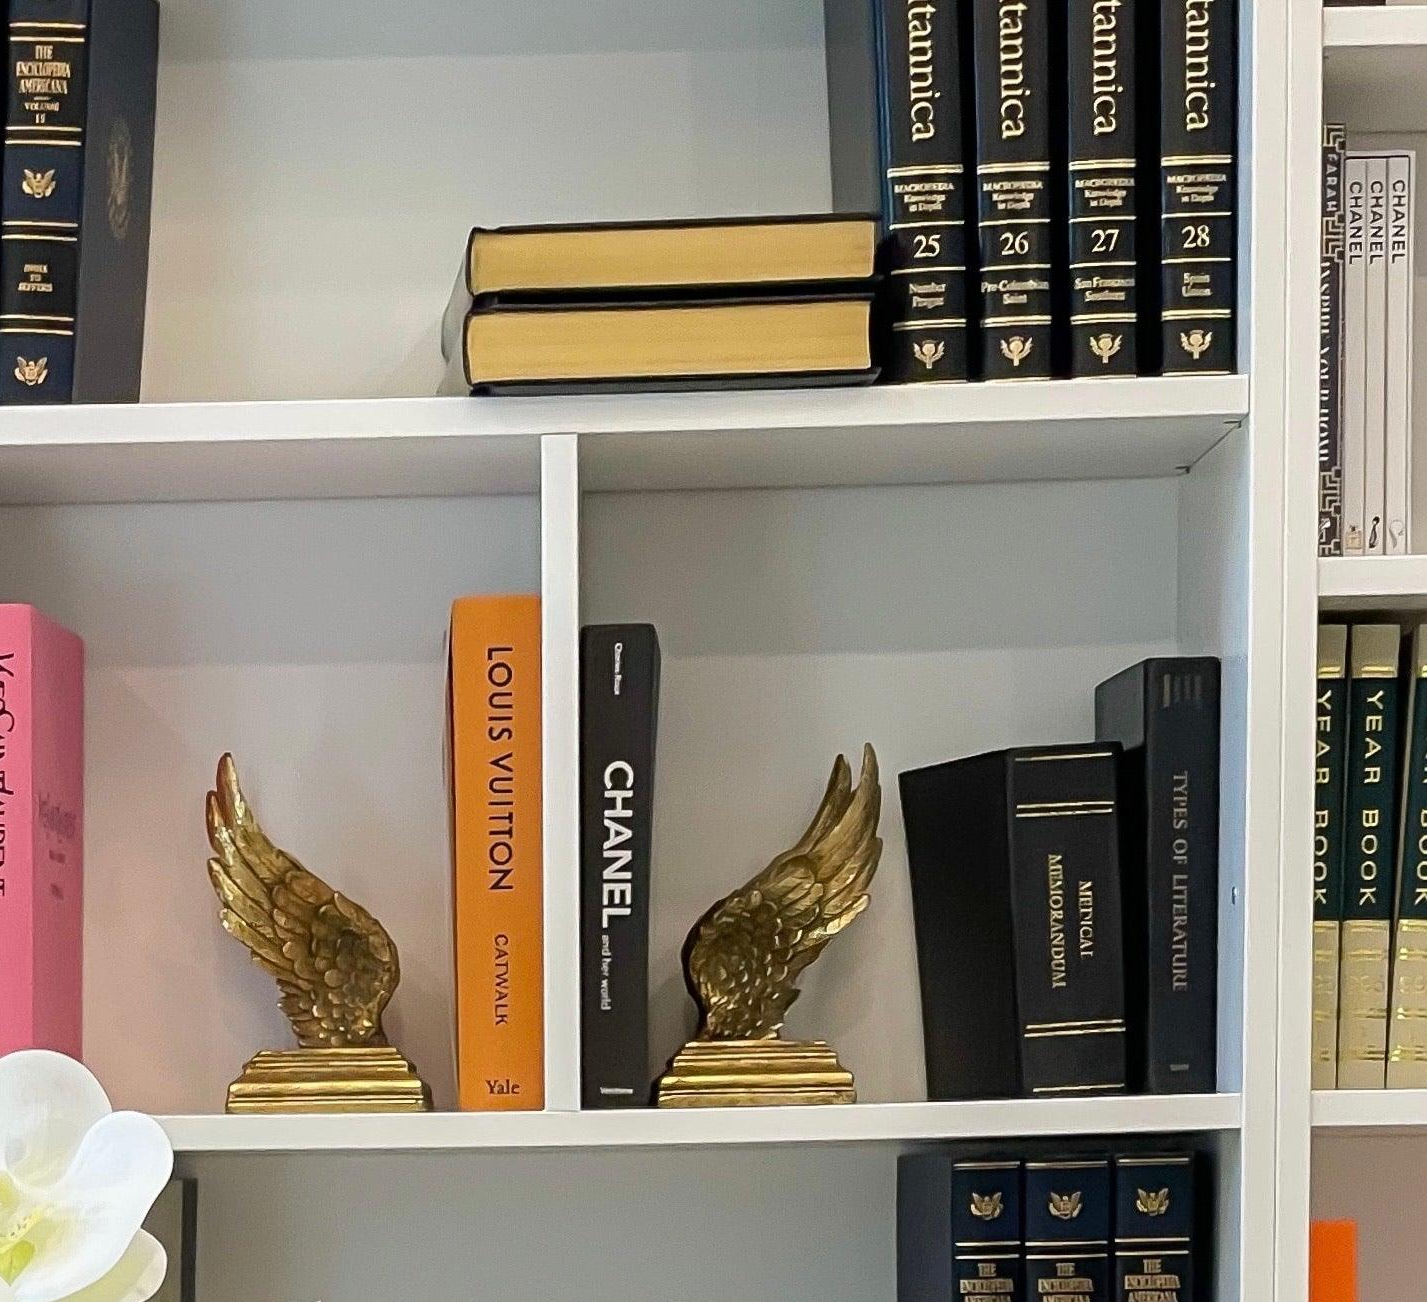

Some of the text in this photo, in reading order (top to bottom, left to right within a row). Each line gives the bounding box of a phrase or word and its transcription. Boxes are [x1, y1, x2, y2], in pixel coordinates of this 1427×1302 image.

[907, 0, 941, 142] tannica
[998, 0, 1032, 140] tannica
[1091, 0, 1124, 136] tannica
[1184, 0, 1216, 132] tannica
[1325, 153, 1339, 212] FARAH
[1348, 181, 1363, 265] CHANEL
[1369, 180, 1384, 265] CHANEL
[1391, 179, 1406, 264] CHANEL
[913, 234, 941, 259] 25
[999, 231, 1029, 256] 26
[1091, 228, 1120, 253] 27
[1181, 224, 1210, 249] 28
[487, 646, 515, 891] LOUIS VUITTON
[1359, 689, 1384, 906] YEAR BOOK
[600, 760, 635, 1011] CHANEL and her world
[1172, 770, 1189, 992] TYPES OF LITERATURE
[493, 933, 510, 1026] CATWALK
[485, 1078, 520, 1096] Yale
